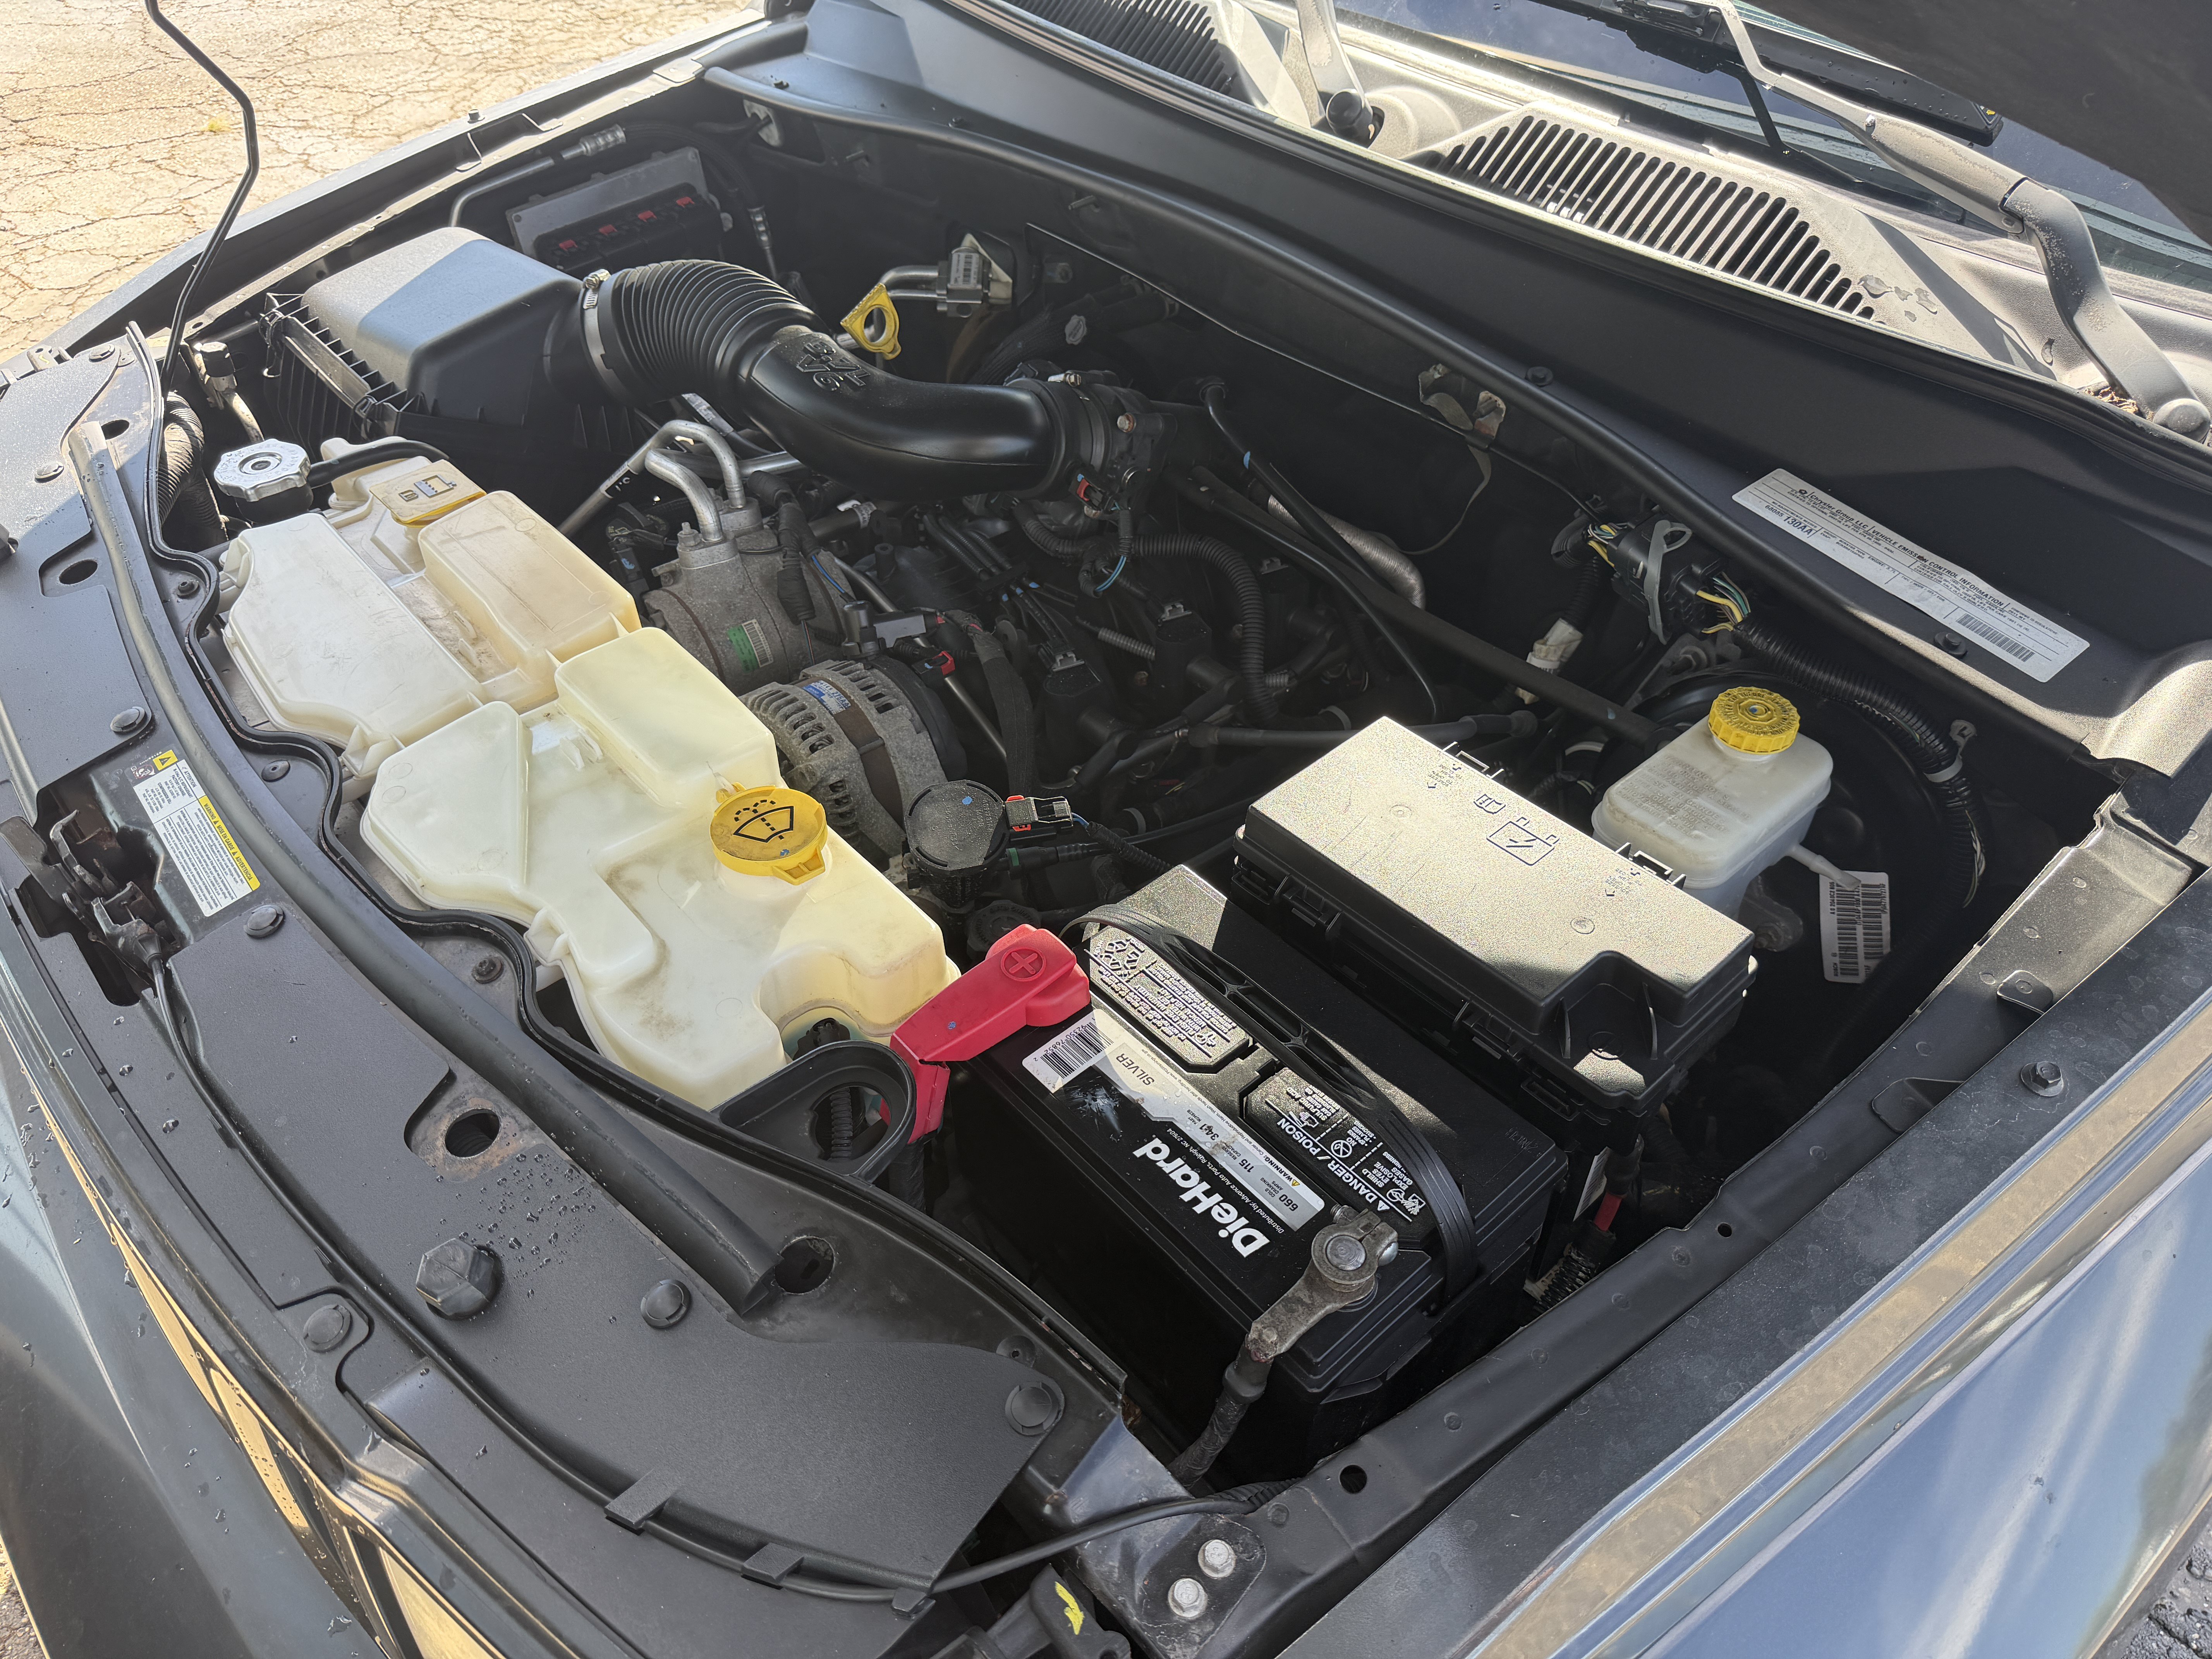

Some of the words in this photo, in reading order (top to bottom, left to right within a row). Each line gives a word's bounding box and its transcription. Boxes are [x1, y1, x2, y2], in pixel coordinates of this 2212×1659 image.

[1764, 504, 1784, 518] 68085
[1783, 515, 1813, 536] 130AA
[1809, 493, 1836, 512] Chrysler
[1834, 508, 1855, 522] Group
[1855, 519, 1868, 530] LLC
[1871, 529, 1898, 547] VEHICLE
[1897, 543, 1928, 564] EMISSIN
[1928, 558, 1958, 581] CONTROL
[1959, 577, 2004, 608] INFORMATION
[184, 769, 197, 788] ATTENTION
[203, 802, 216, 821] WARNING
[216, 824, 225, 835] MISE
[224, 838, 235, 851] GARDE
[234, 855, 253, 882] ADVERTENCIA
[1607, 875, 1623, 886] OPEN
[1100, 973, 1121, 992] CHILDREN
[1109, 974, 1119, 984] AND
[1116, 981, 1130, 993] TIGHT
[1125, 994, 1140, 1008] REACH
[1128, 990, 1141, 1003] CAPS
[1134, 982, 1167, 1012] IMMEDIATELY
[1157, 994, 1170, 1006] GET
[1158, 986, 1173, 1000] FAST
[1137, 1005, 1147, 1015] THE
[1139, 1000, 1151, 1011] VENT
[1170, 996, 1186, 1010] HELP
[1149, 1008, 1162, 1020] KEEP
[1164, 1008, 1180, 1022] EYES
[1183, 1007, 1207, 1028] MEDICAL
[1152, 1018, 1163, 1028] OUT
[1176, 1018, 1196, 1036] FLUSH
[1185, 1018, 1201, 1032] WITH
[1065, 1023, 1086, 1041] 92350
[1177, 1032, 1187, 1041] DO
[1043, 1038, 1065, 1055] 76852
[1115, 1050, 1156, 1088] SILVER
[1189, 1090, 1198, 1098] after
[1196, 1096, 1207, 1106] hands
[1285, 1085, 1302, 1101] ACID
[1205, 1104, 1216, 1114] Wash
[1298, 1095, 1328, 1123] SULFURIC
[1306, 1094, 1322, 1109] CAUSE
[1312, 1092, 1336, 1115] BLINDNESS
[1186, 1108, 1202, 1123] NUMBER
[1321, 1106, 1332, 1117] CAN
[1187, 1115, 1198, 1125] PART
[1166, 1127, 1183, 1143] 27604
[1276, 1115, 1321, 1157] POISON
[1351, 1124, 1370, 1142] FLAMES
[1353, 1118, 1374, 1139] SMOKING
[1180, 1139, 1190, 1149] NC
[1244, 1137, 1252, 1146] and
[1345, 1135, 1357, 1147] NO
[1346, 1128, 1366, 1146] SPARKS
[1188, 1145, 1208, 1164] Raleigh,
[1221, 1145, 1238, 1161] RESERVE
[1250, 1142, 1264, 1156] Cancer
[1316, 1150, 1331, 1164] /
[1205, 1161, 1221, 1176] Parts,
[1238, 1157, 1255, 1173] 115
[1262, 1153, 1293, 1182] WARNING:
[1218, 1173, 1232, 1187] Auto
[1326, 1158, 1377, 1205] DANGER
[1360, 1166, 1385, 1189] SHIELD
[1371, 1167, 1390, 1185] EYES
[1373, 1159, 1409, 1192] EXPLOSIVE
[1390, 1165, 1413, 1187] GASES
[1230, 1183, 1251, 1204] Advance
[1260, 1176, 1279, 1195] CRANKING
[1264, 1187, 1276, 1198] COLD
[1271, 1180, 1283, 1192] AMPS
[1132, 1137, 1271, 1259] DieHard
[1249, 1200, 1259, 1211] by:
[1277, 1191, 1300, 1214] 660
[1254, 1206, 1285, 1237] Distributed
